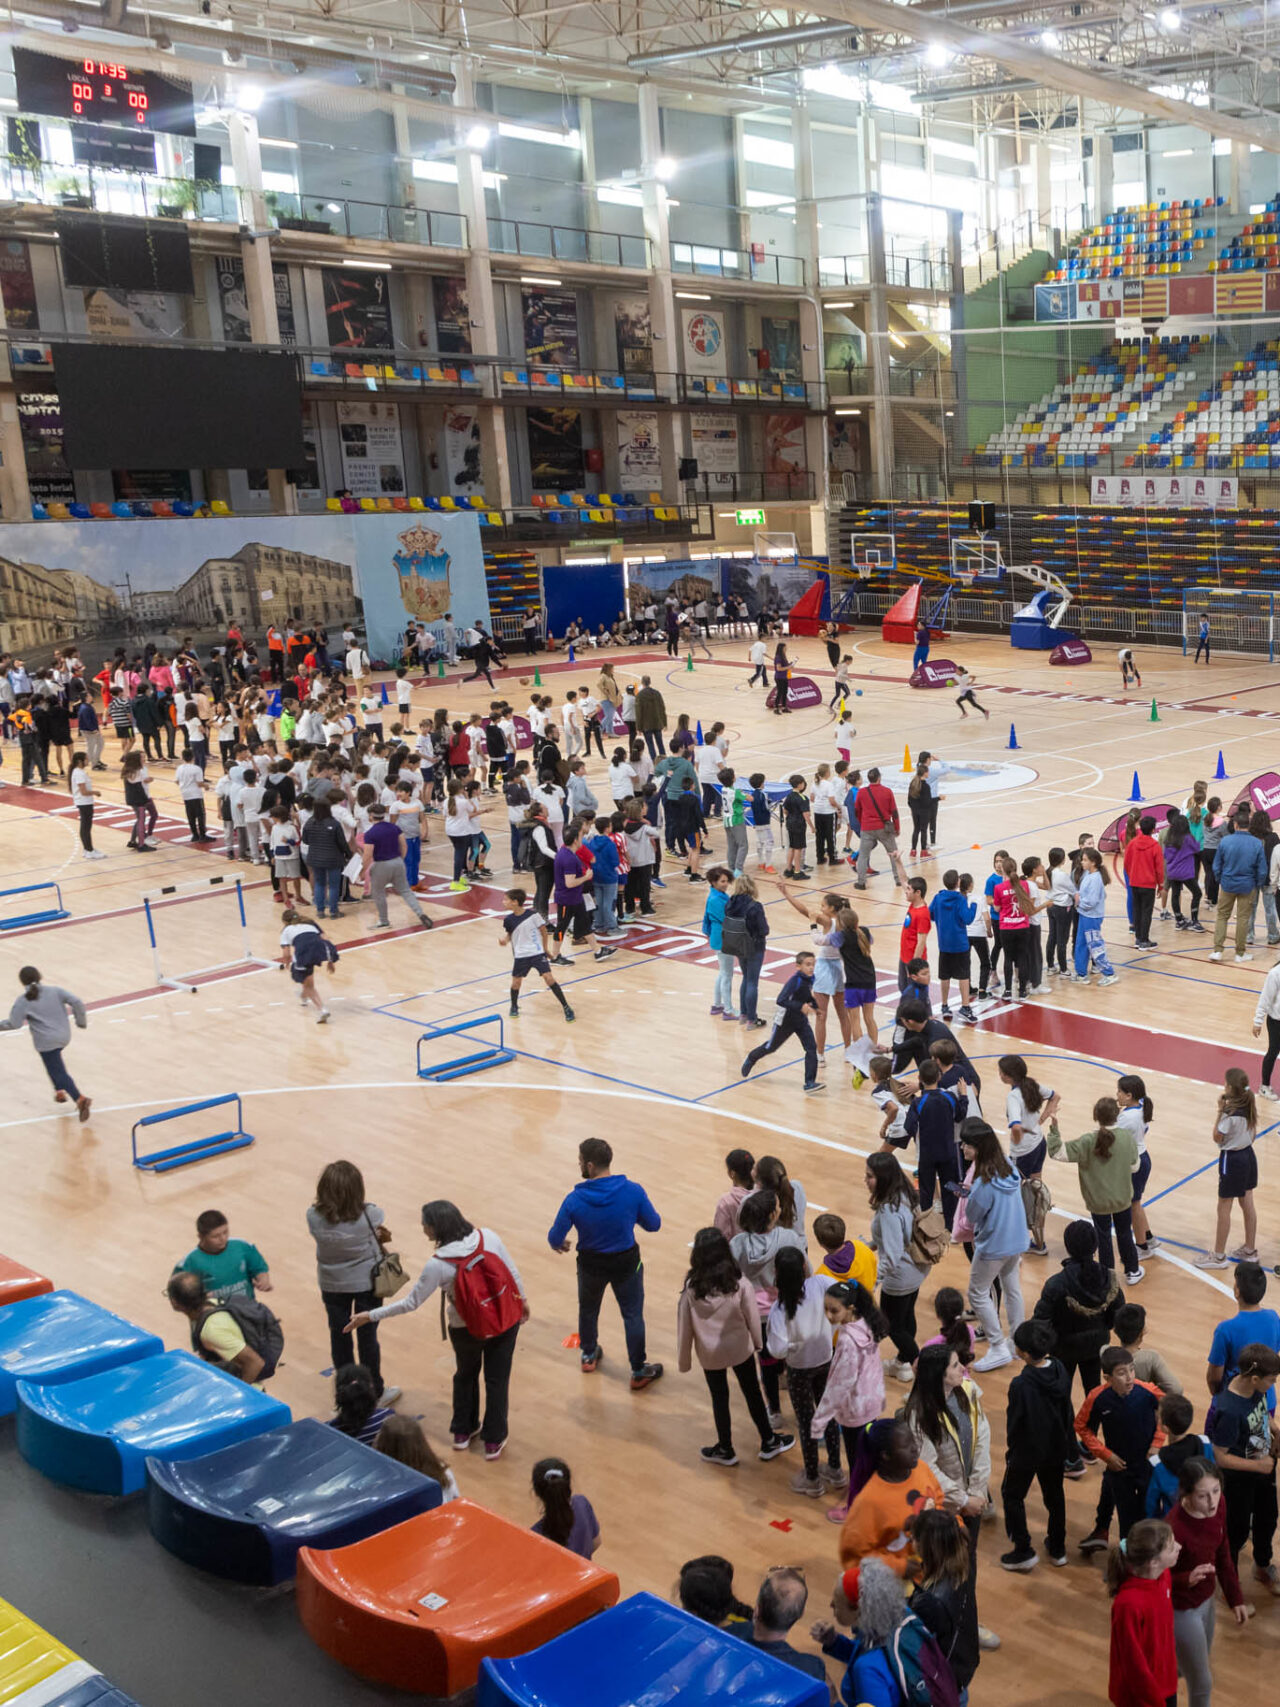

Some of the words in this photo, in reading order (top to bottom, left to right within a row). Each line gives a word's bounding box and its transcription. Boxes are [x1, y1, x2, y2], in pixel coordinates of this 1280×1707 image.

[84, 58, 128, 80] 01:35
[67, 73, 91, 84] LOCAL
[72, 83, 93, 100] 00
[104, 84, 112, 97] 3
[73, 101, 83, 115] 0
[128, 92, 149, 110] 00
[136, 111, 145, 124] 0
